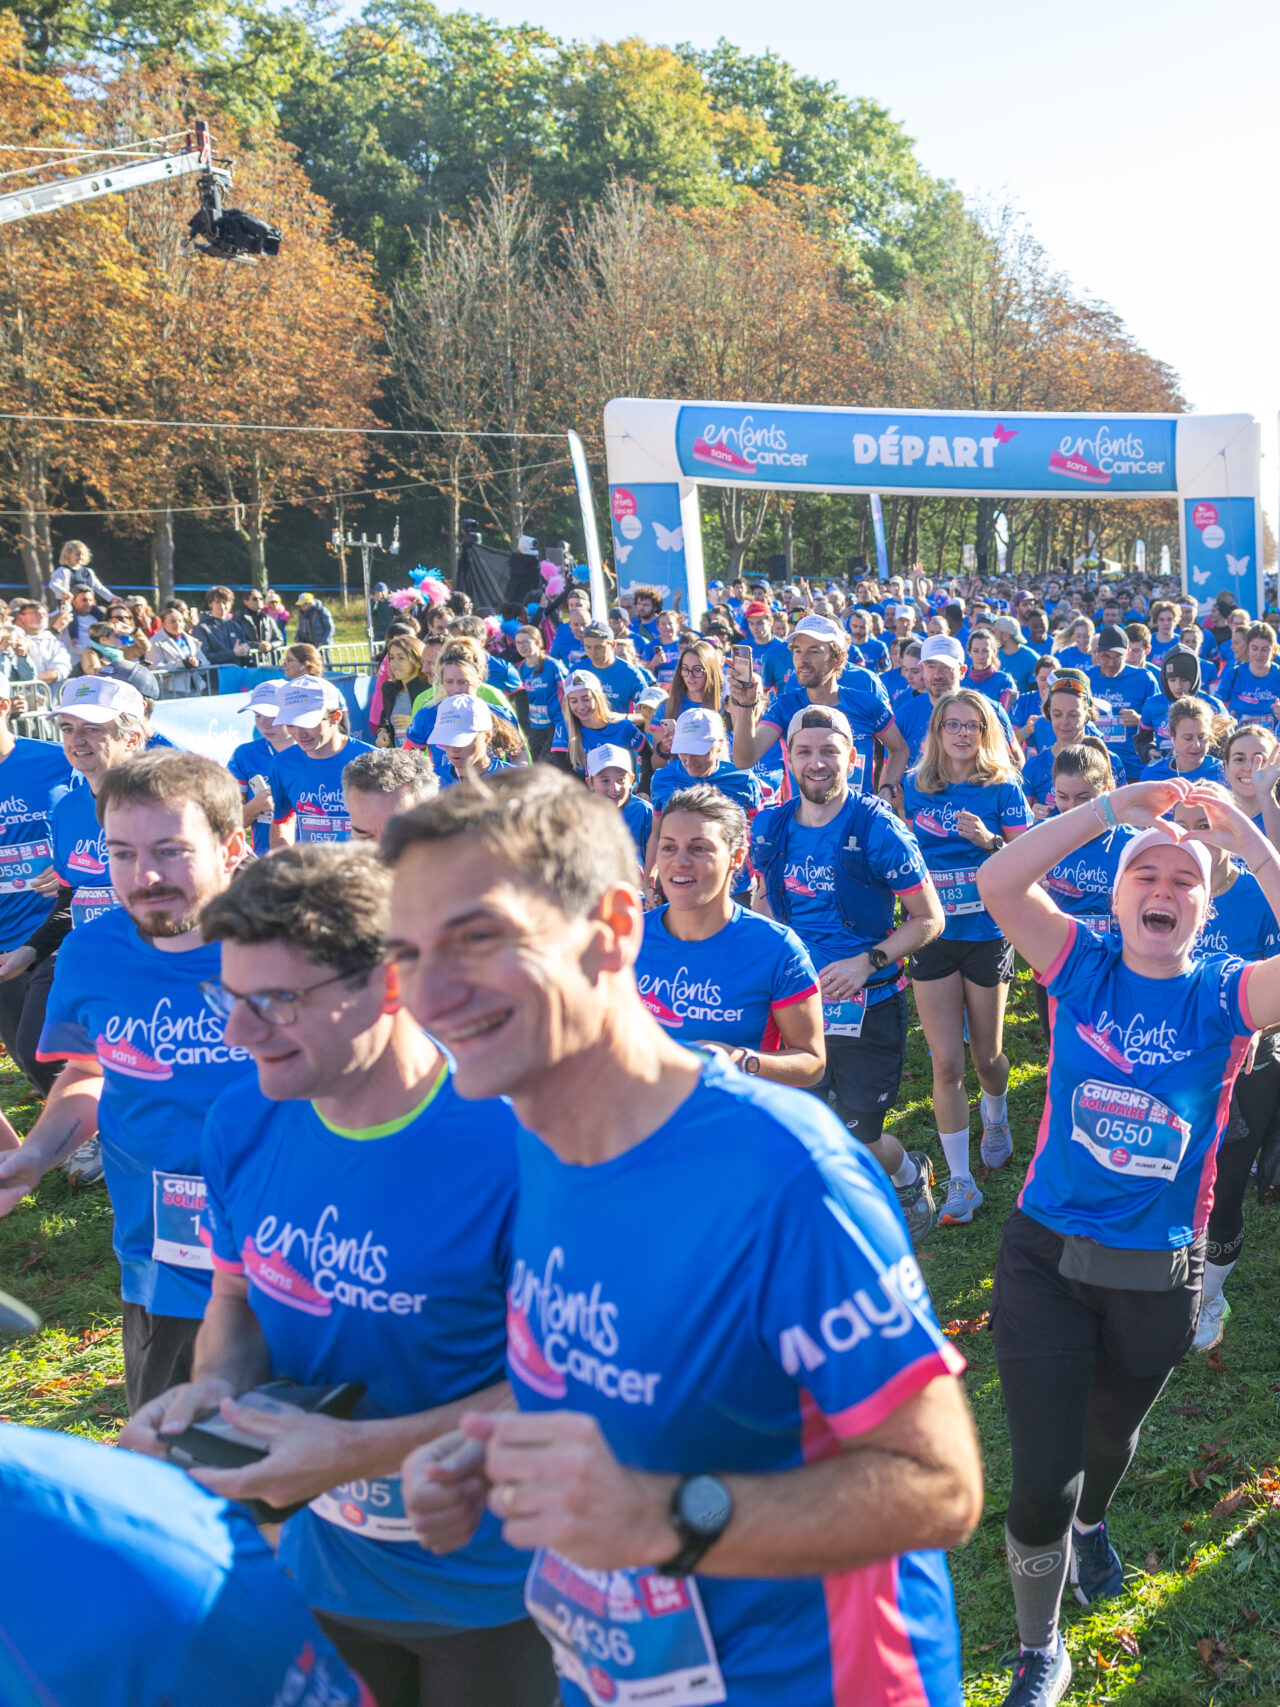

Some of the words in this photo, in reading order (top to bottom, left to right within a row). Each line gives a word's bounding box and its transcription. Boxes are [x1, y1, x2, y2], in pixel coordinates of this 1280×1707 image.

[703, 415, 788, 450] enfants
[1060, 426, 1144, 459] enfants
[711, 448, 732, 462] sans
[743, 447, 809, 467] Cancer
[852, 425, 999, 468] DÉPART
[1066, 460, 1088, 473] sans
[1099, 458, 1166, 475] Cancer
[1053, 860, 1108, 884] enfants
[1077, 880, 1115, 895] Cance
[639, 966, 722, 1006] enfants
[106, 998, 224, 1050] enfants
[673, 1000, 745, 1022] Cancer
[1096, 1010, 1178, 1051] enfants
[112, 1049, 138, 1066] sans
[155, 1043, 255, 1066] Cance
[1079, 1095, 1146, 1121] SOLIDAIRE
[1082, 1084, 1150, 1110] COURONS
[1094, 1117, 1153, 1147] 0550
[163, 1178, 207, 1197] COUR
[163, 1192, 207, 1211] SOLID
[257, 1204, 388, 1285] enfants
[260, 1261, 293, 1290] sans
[314, 1268, 428, 1315] Cancer
[512, 1245, 620, 1358] enfants
[544, 1332, 663, 1407] Cancer
